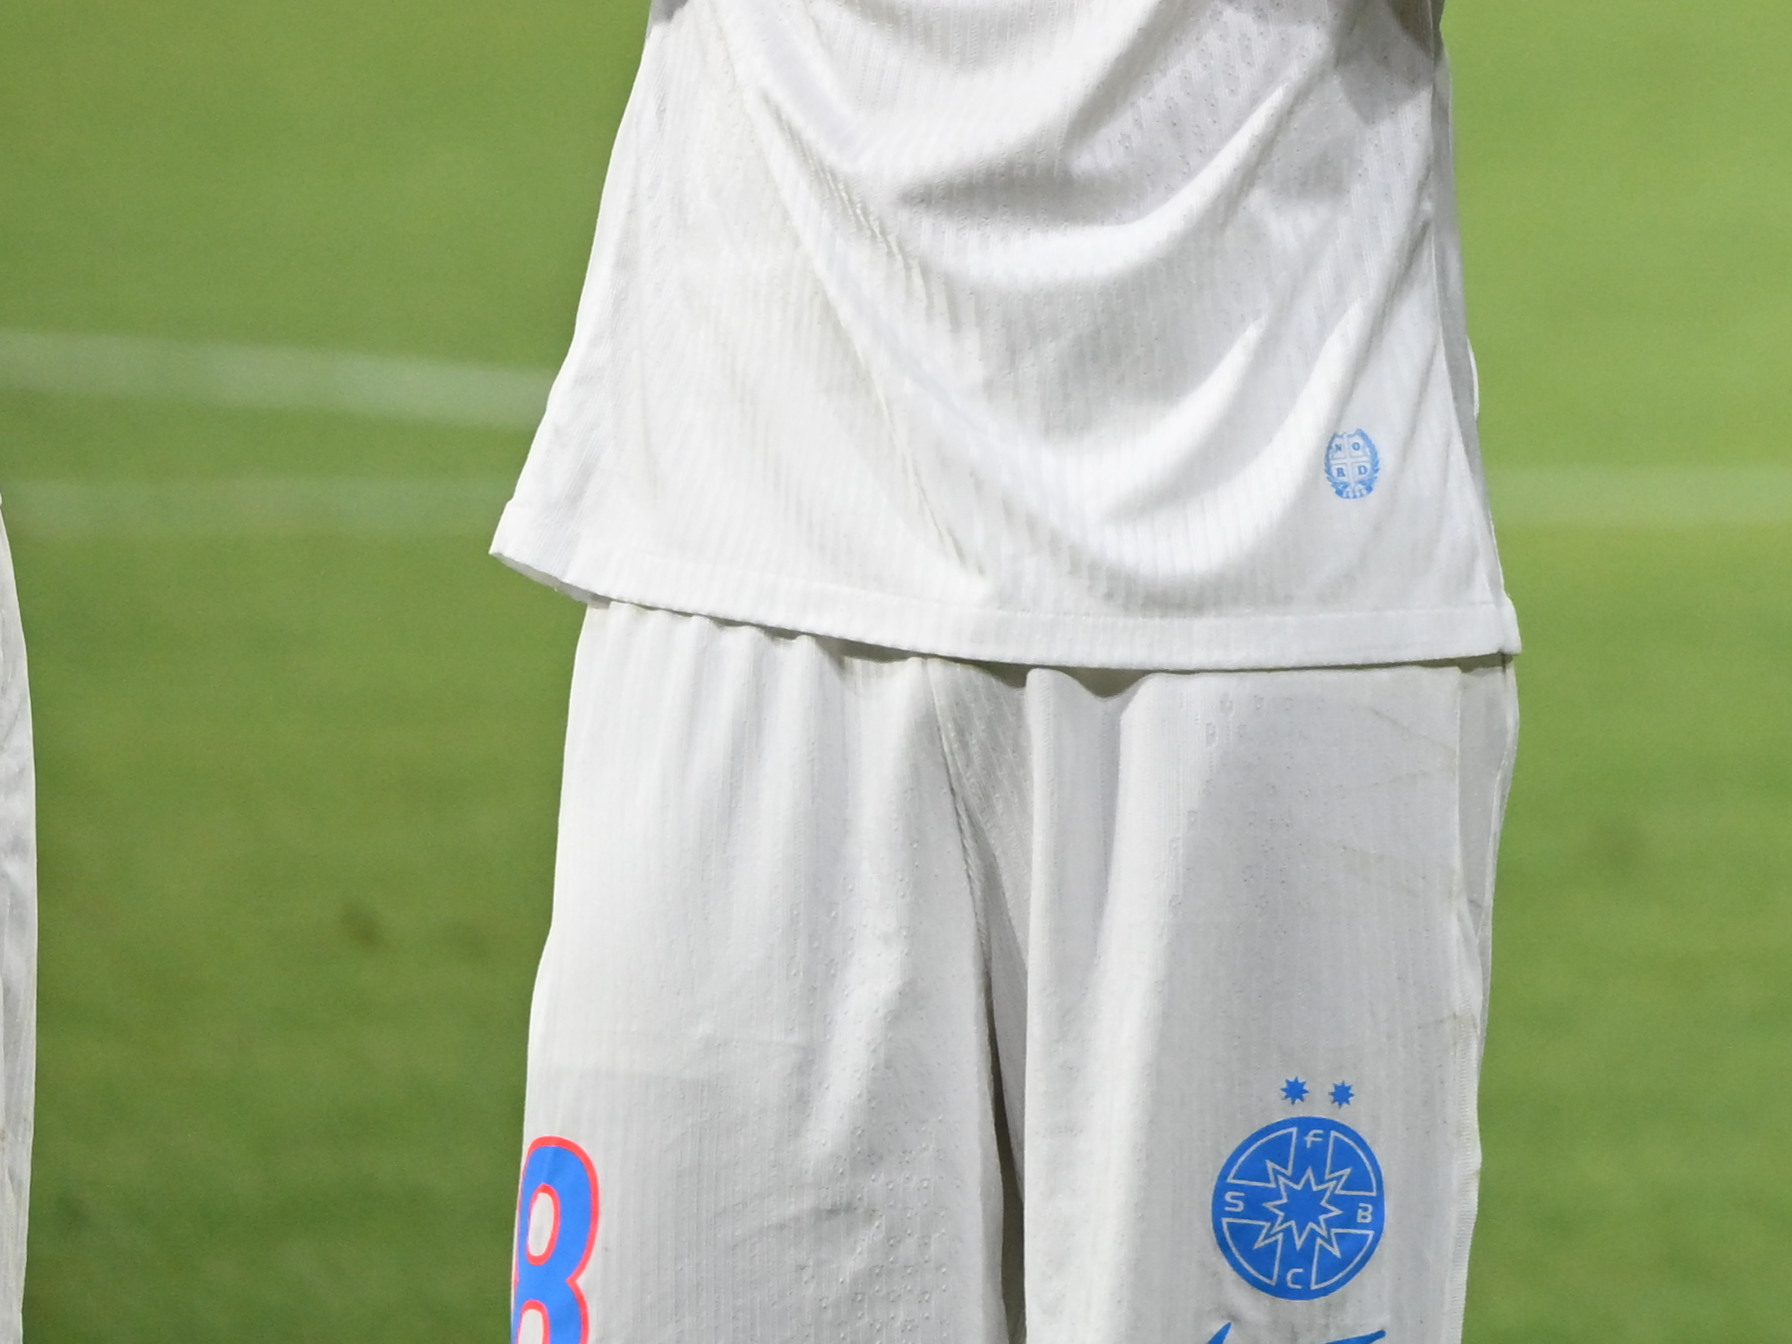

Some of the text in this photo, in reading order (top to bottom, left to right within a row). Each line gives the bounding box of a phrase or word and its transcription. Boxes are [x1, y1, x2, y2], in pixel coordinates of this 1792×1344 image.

[1351, 441, 1361, 452] O
[1336, 466, 1346, 478] R
[1356, 464, 1368, 476] D
[1224, 1190, 1246, 1213] S
[1356, 1202, 1374, 1224] B
[1286, 1268, 1305, 1290] C
